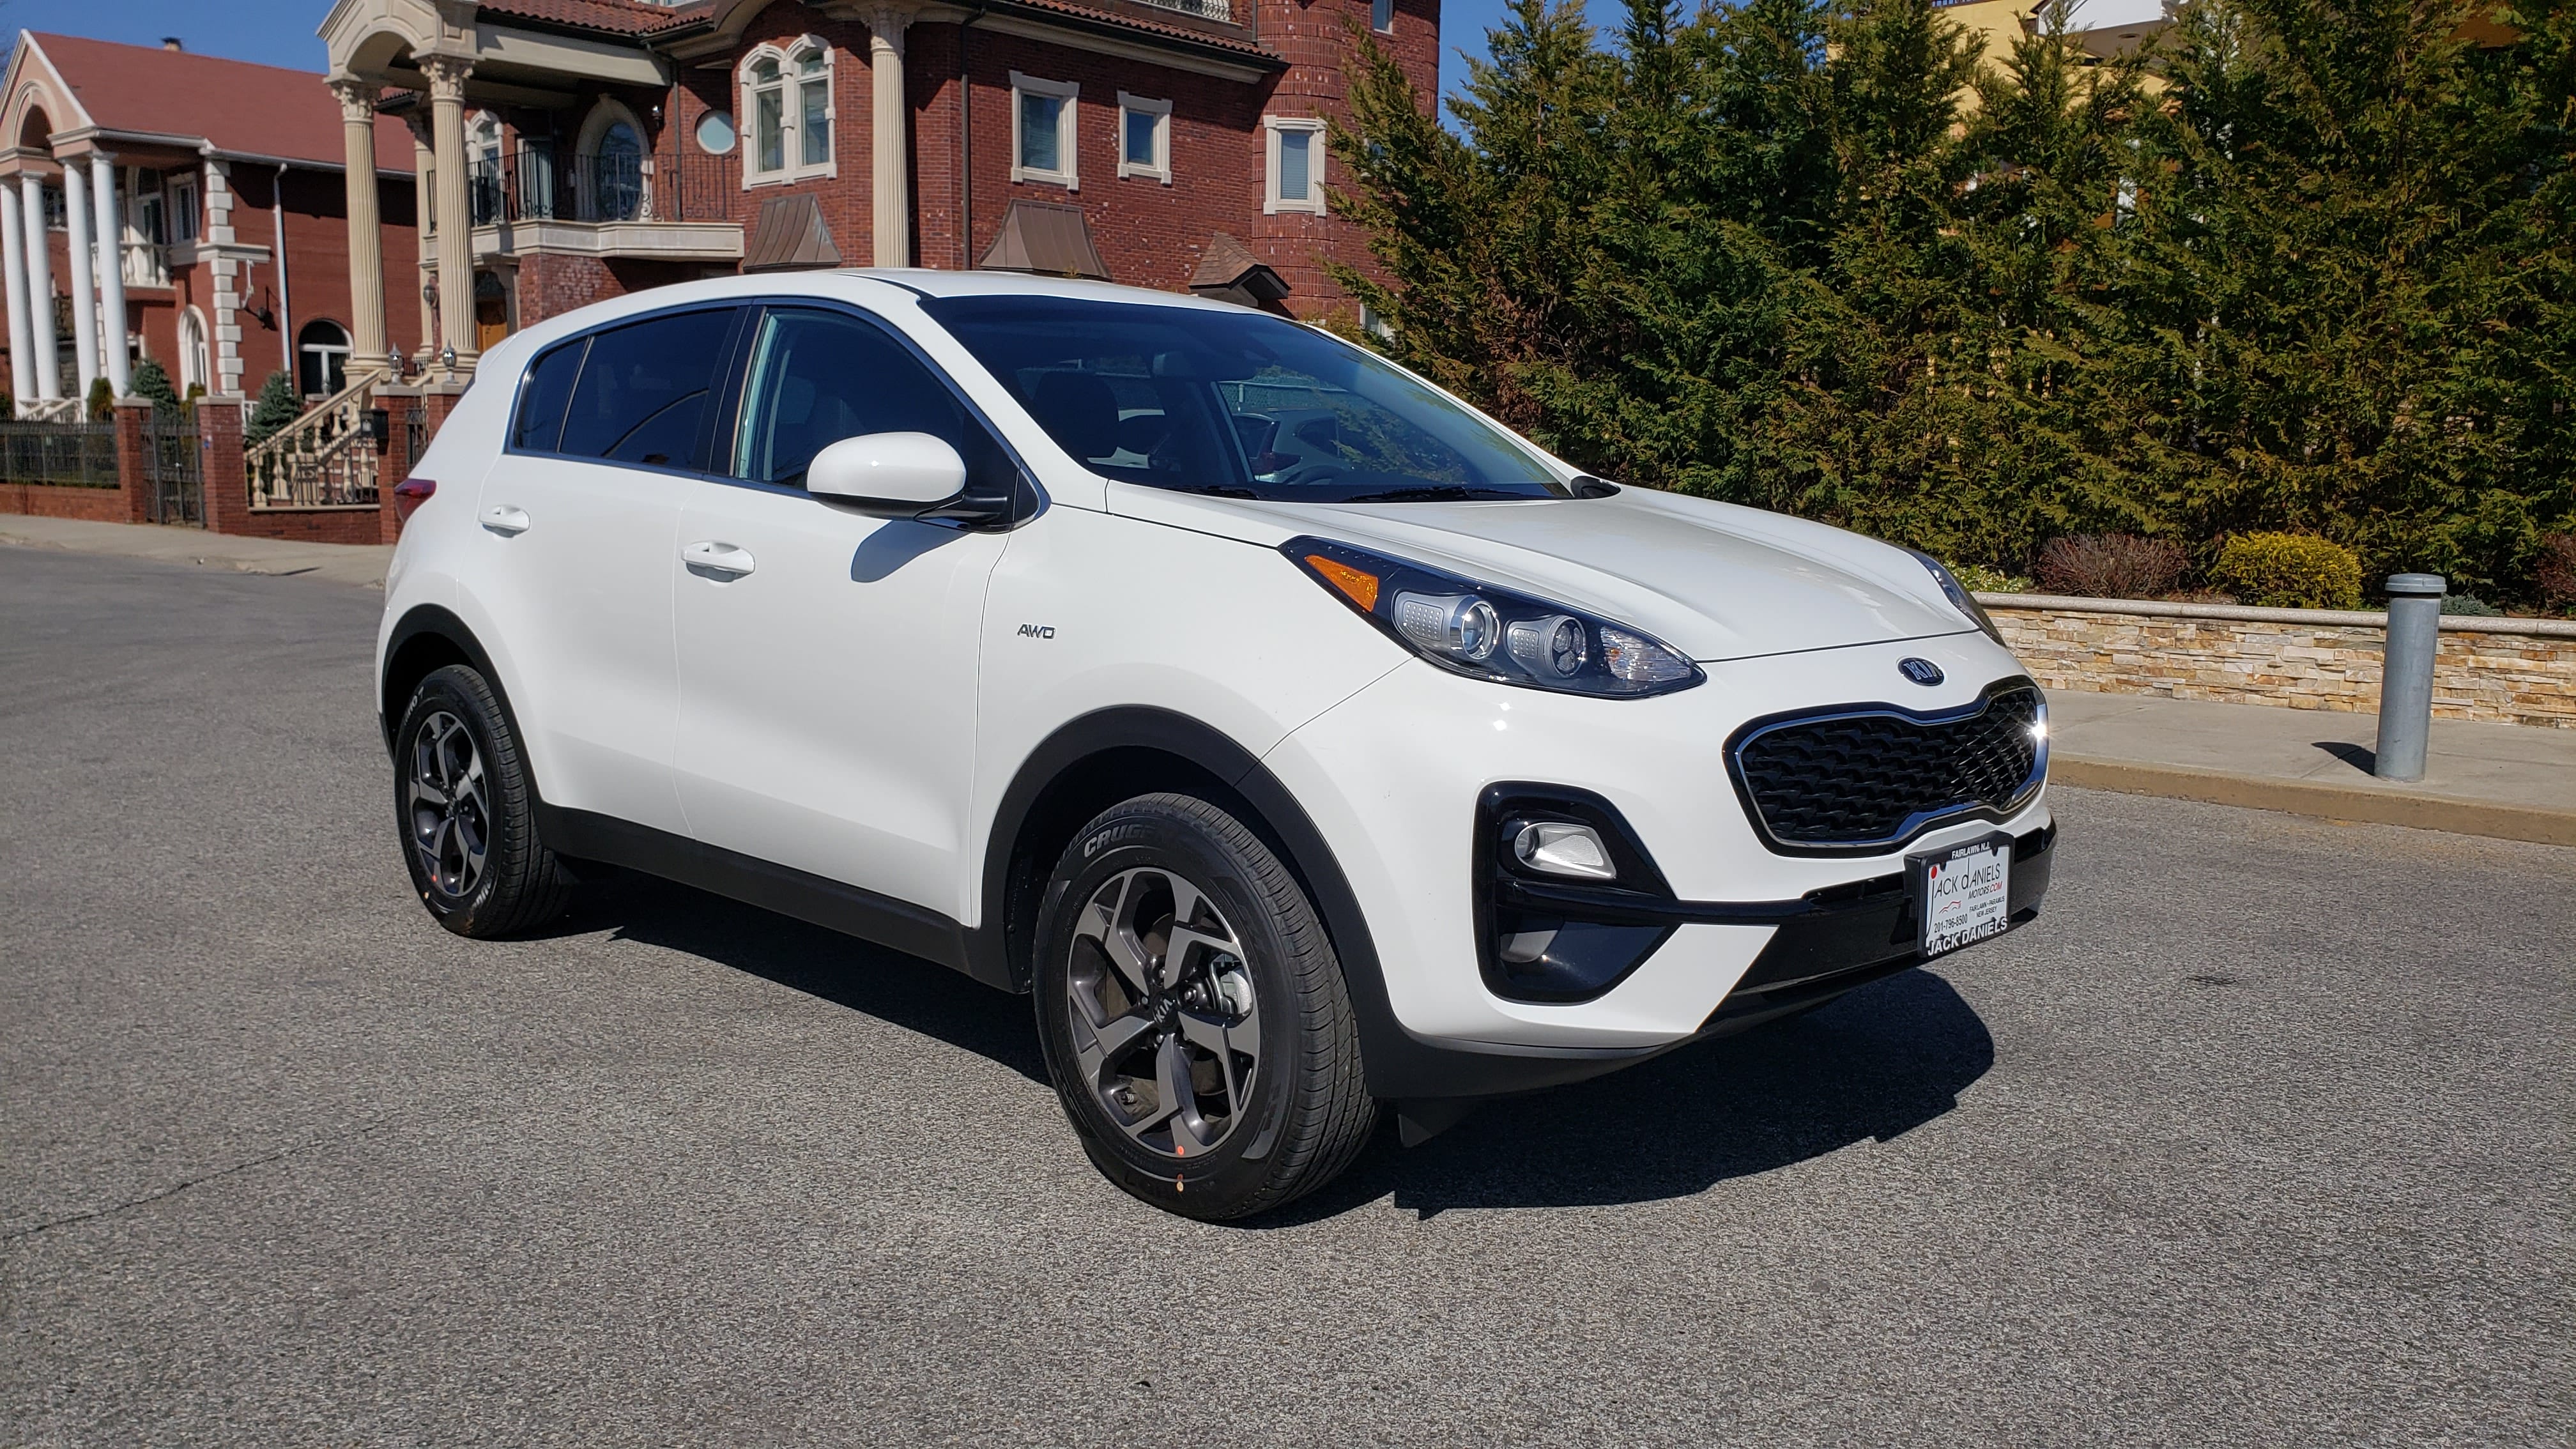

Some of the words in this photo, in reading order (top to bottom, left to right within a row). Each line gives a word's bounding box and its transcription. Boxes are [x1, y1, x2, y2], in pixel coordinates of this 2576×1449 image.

[1017, 624, 1055, 639] AWD
[1968, 881, 2002, 900] MOTORS.COM
[1984, 906, 1997, 915] JERSEY
[1934, 913, 1968, 933] 201-796-8500
[1928, 933, 1959, 956] JACK
[1962, 917, 2007, 944] DANIELS
[1156, 999, 1173, 1023] KIA
